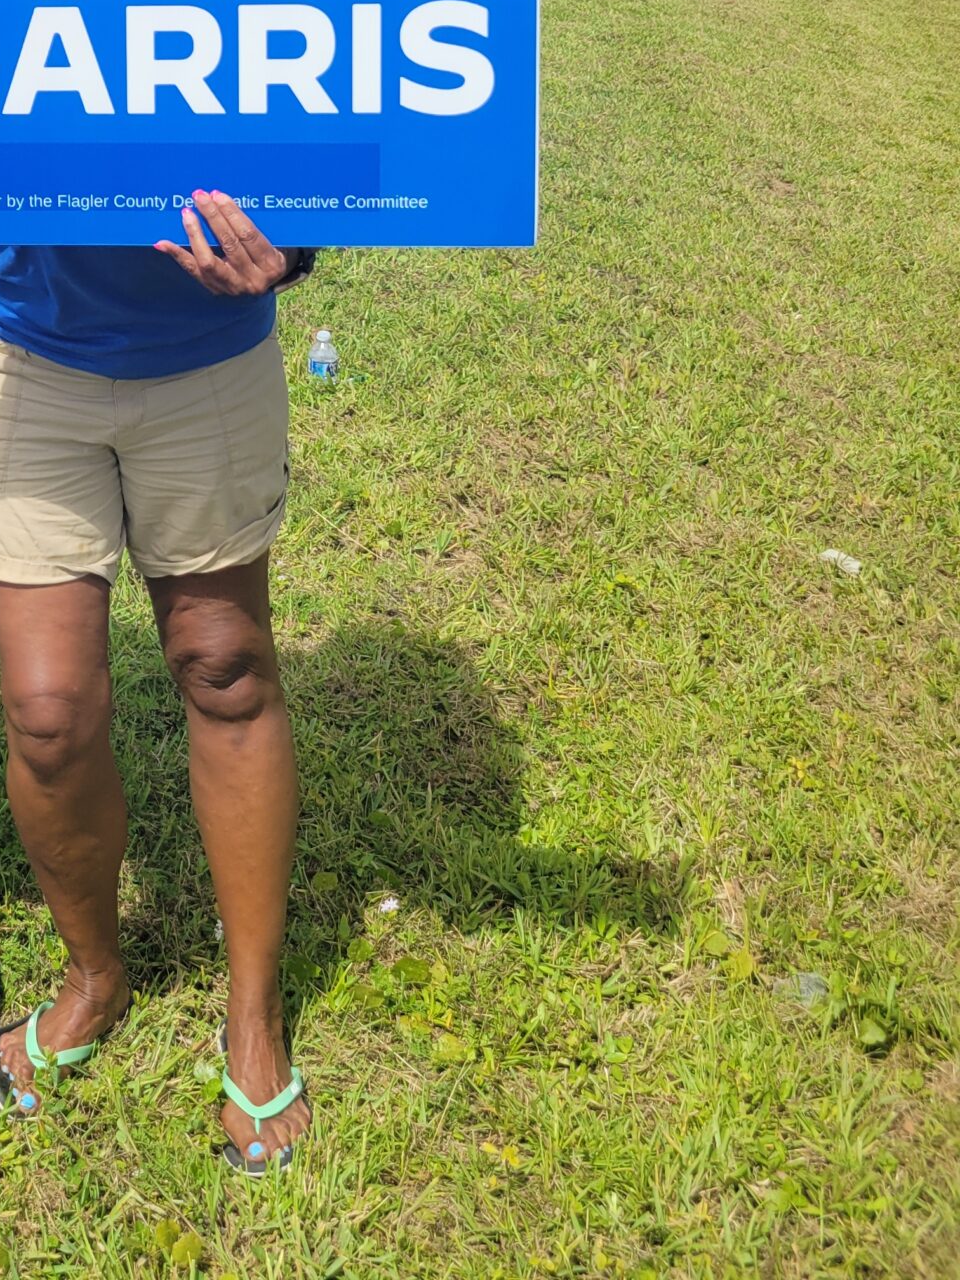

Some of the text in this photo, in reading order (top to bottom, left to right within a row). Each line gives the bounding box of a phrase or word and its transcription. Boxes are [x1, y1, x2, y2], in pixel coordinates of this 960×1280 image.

[7, 194, 24, 210] by
[28, 194, 52, 207] the
[57, 194, 109, 210] Flagler
[113, 194, 167, 210] County
[172, 194, 259, 208] Deatic
[264, 194, 338, 208] Executive
[344, 194, 428, 208] Committee
